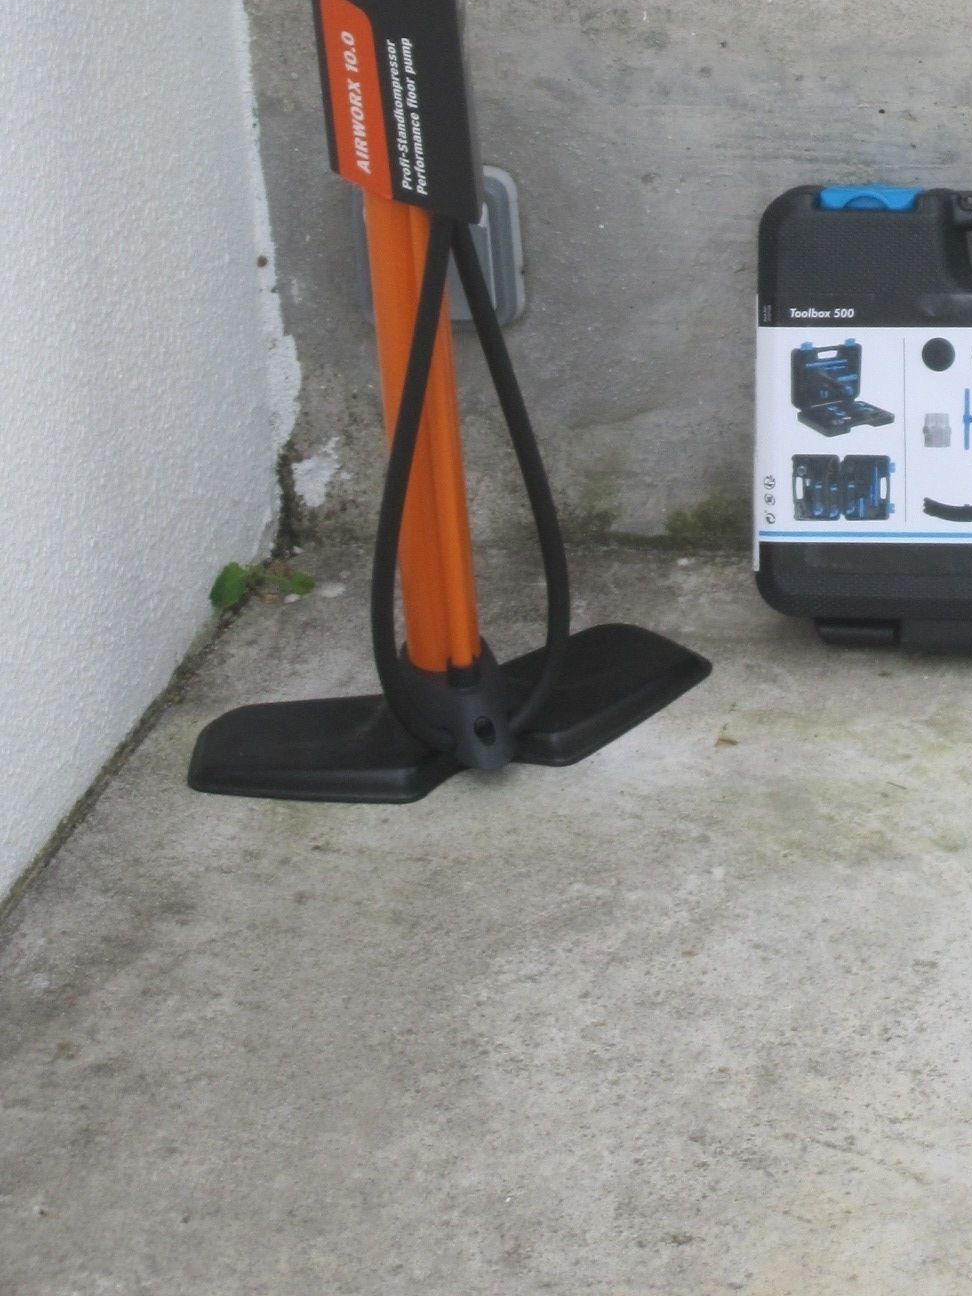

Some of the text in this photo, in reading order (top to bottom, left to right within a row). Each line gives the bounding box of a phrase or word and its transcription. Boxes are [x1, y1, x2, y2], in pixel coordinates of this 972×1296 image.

[340, 30, 371, 175] AIRWORX 10.0
[386, 38, 413, 191] Profi-Standkompressor
[401, 37, 428, 196] Performance floor pump
[789, 308, 855, 319] Toolbox 500
